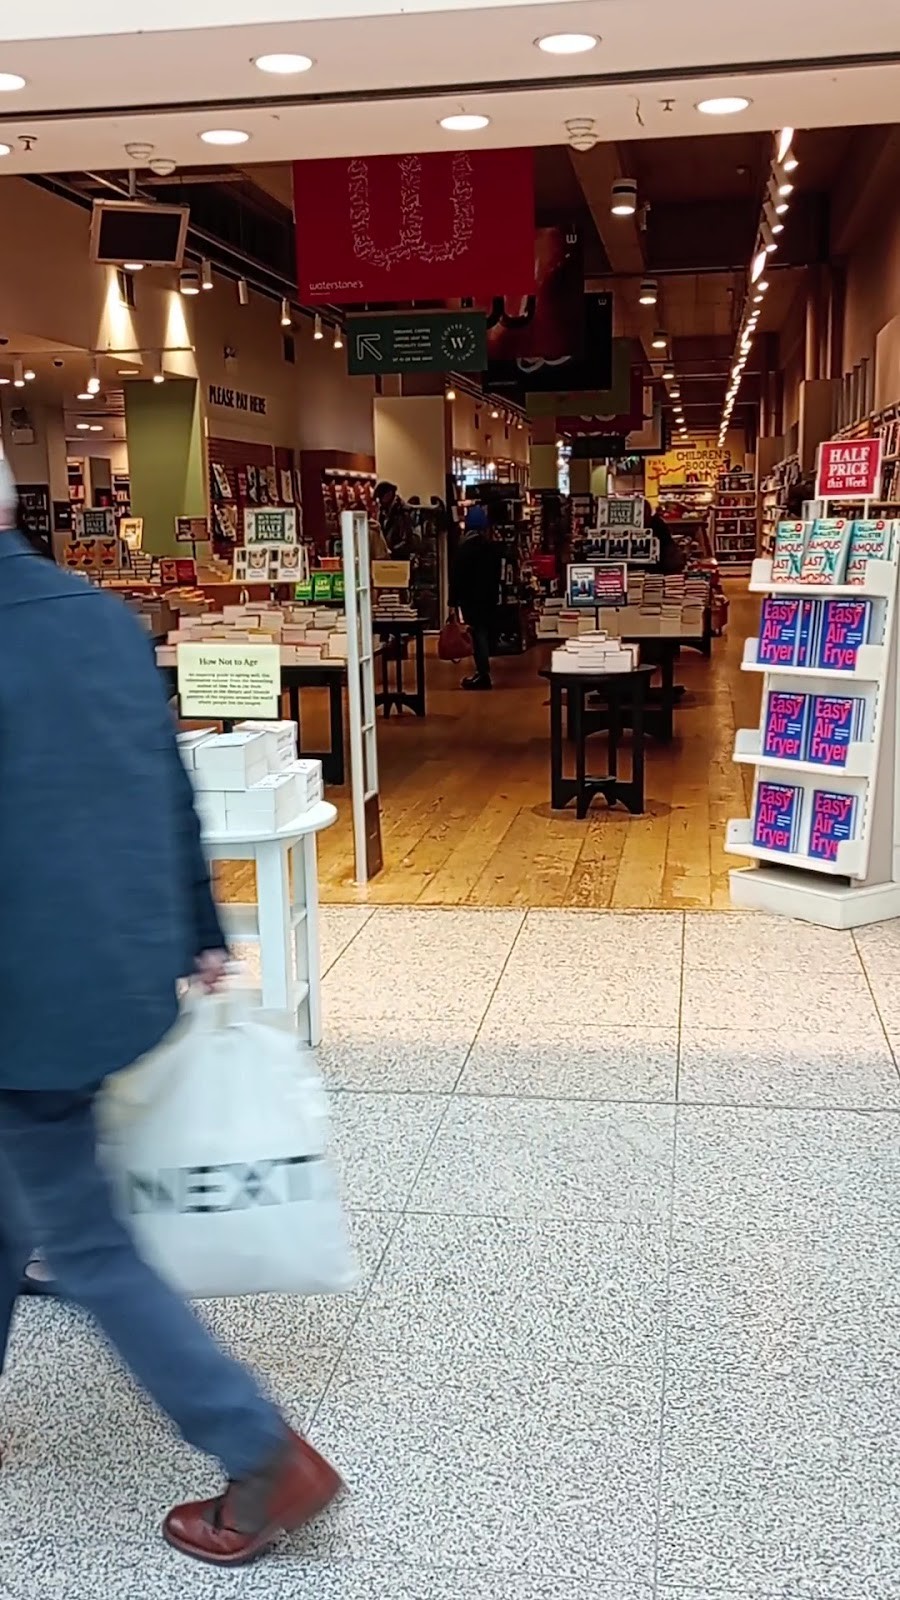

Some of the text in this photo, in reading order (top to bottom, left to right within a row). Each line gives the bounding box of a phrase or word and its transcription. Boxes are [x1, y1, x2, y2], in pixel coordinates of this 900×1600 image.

[450, 337, 466, 349] W
[209, 384, 266, 415] PLEASE PAY HERE
[686, 460, 718, 470] BOOKS
[829, 447, 870, 463] HALF
[828, 462, 870, 477] PRICE
[827, 477, 867, 489] this Week
[804, 557, 824, 566] LAST
[764, 601, 795, 625] Easy
[828, 602, 863, 628] Easy
[763, 620, 782, 639] Air
[826, 623, 847, 643] Air
[760, 639, 793, 665] Fryer
[199, 658, 216, 666] How
[218, 658, 233, 666] Not
[244, 658, 258, 667] Age
[770, 694, 801, 719] Easy
[815, 698, 850, 724] Easy
[768, 713, 787, 733] Air
[814, 718, 835, 738] Air
[766, 732, 799, 757] Fryer
[761, 785, 791, 812] Easy
[816, 792, 850, 821] Easy
[759, 805, 777, 824] Air
[814, 813, 834, 834] Air
[755, 823, 789, 849] Fryer
[126, 1153, 325, 1214] NEXT
